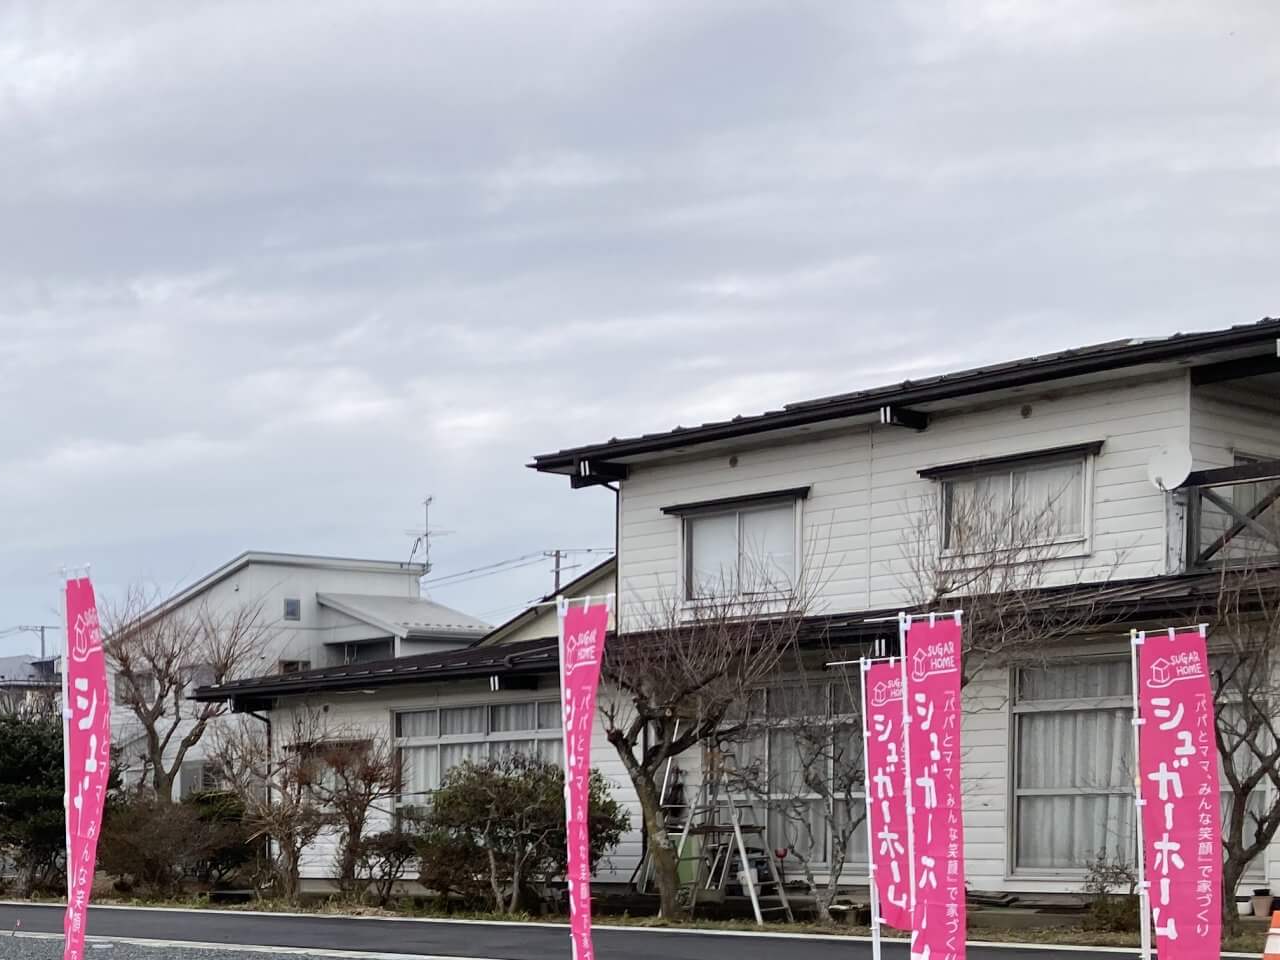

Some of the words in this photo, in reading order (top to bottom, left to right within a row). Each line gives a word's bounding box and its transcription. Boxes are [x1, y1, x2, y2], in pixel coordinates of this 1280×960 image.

[927, 640, 955, 657] SUGAR
[930, 656, 956, 669] HOME
[1169, 650, 1201, 666] SUGAR
[1175, 663, 1203, 677] HOME
[887, 678, 903, 689] SUG
[890, 687, 904, 697] HOM
[873, 714, 907, 910] シュガーホーム
[1147, 697, 1197, 940] シュガーホーム
[1195, 692, 1213, 937] 「パパとママ、みんな笑顔」で家づくり
